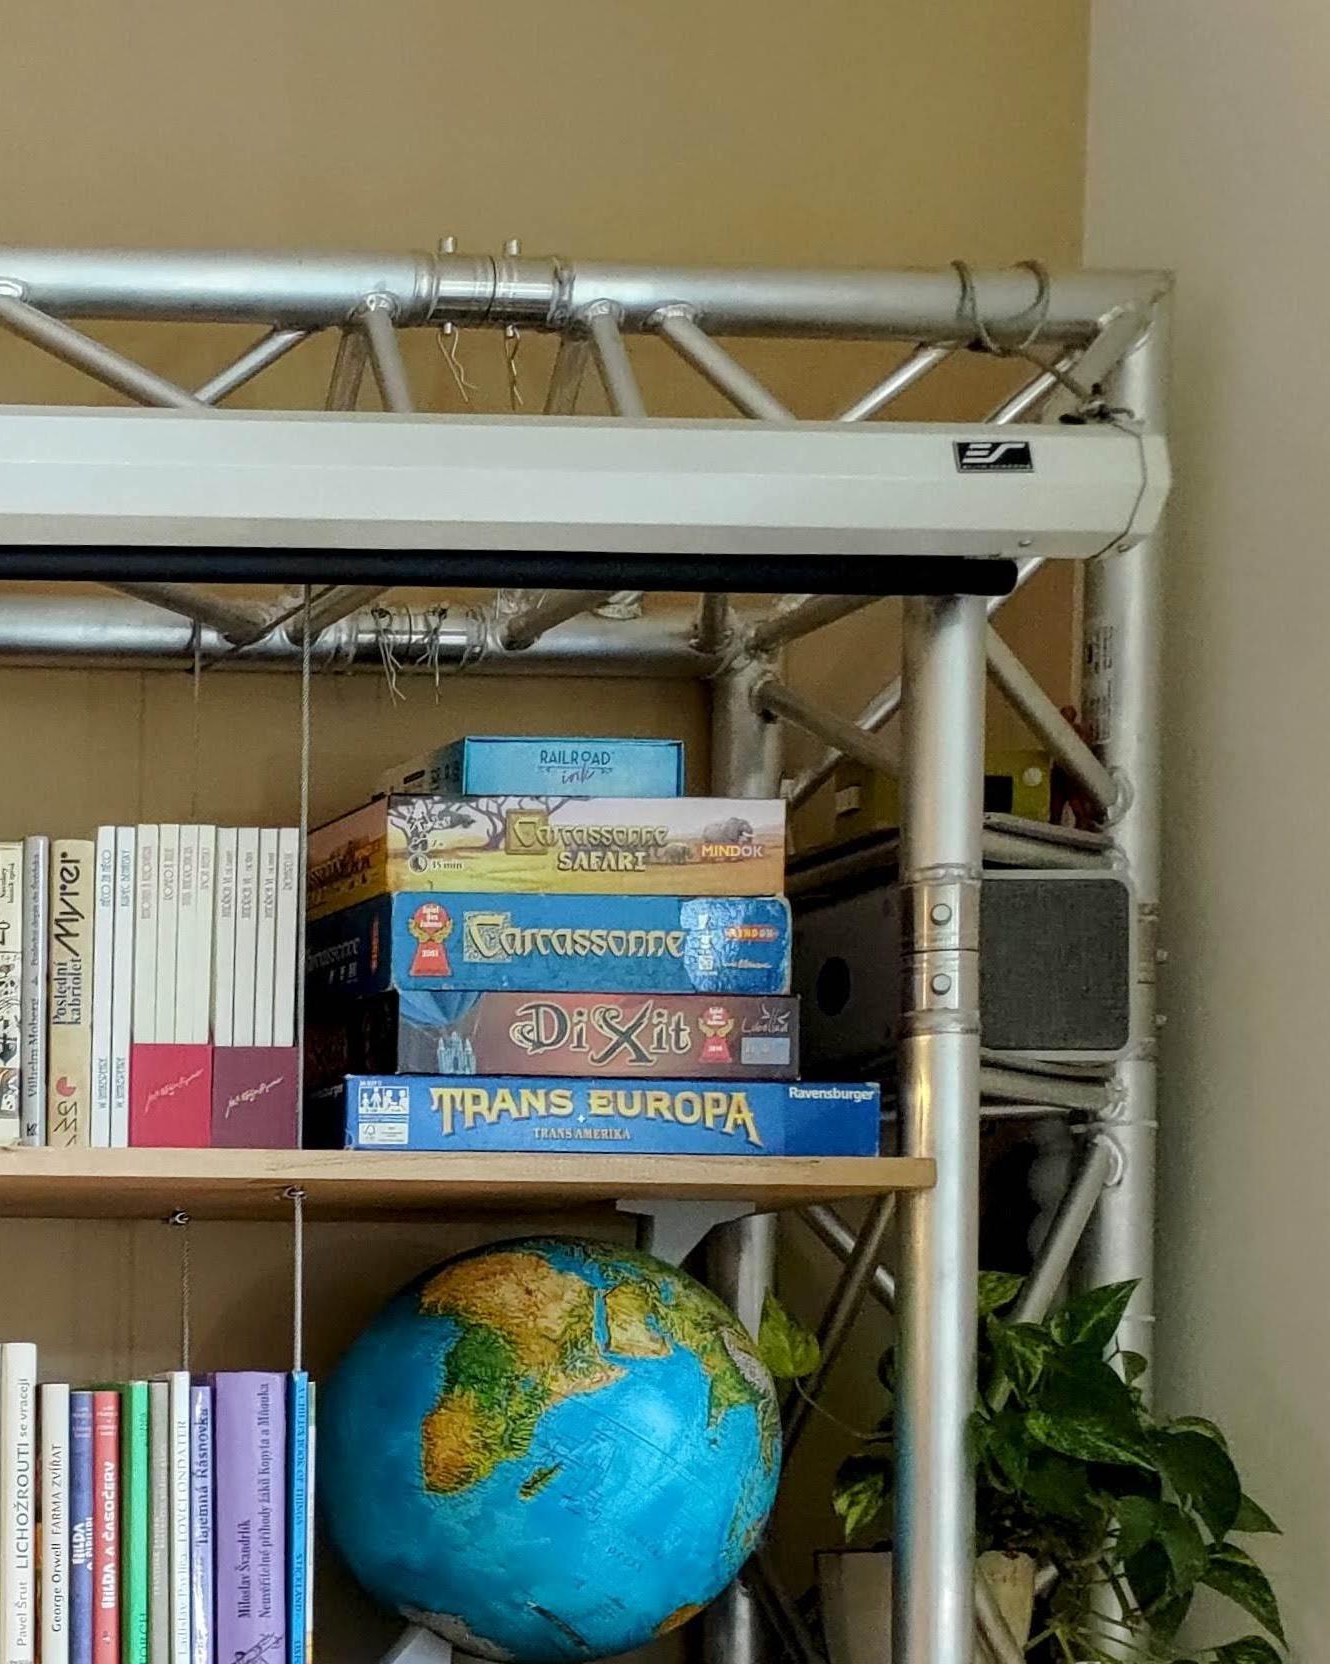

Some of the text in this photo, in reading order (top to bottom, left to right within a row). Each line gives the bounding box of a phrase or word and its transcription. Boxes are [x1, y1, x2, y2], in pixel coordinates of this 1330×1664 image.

[539, 750, 611, 765] RAILROAD
[512, 816, 670, 849] Carcassonne
[701, 843, 764, 858] MINDOK
[557, 850, 648, 873] SAFARI
[52, 851, 85, 1025] Poslední Myrer
[468, 914, 686, 960] Carcassonne
[67, 956, 82, 1025] kabriolet
[788, 1086, 874, 1102] Ravensburger
[429, 1087, 763, 1148] TRANS EUROPA
[532, 1128, 631, 1140] TRANS AMERIKA
[20, 1425, 28, 1438] se
[257, 1438, 272, 1475] Kopyta
[13, 1442, 30, 1569] LICHOŽROUTI
[102, 1461, 116, 1542] ČASOČERV
[194, 1485, 210, 1546] Tajemná
[48, 1443, 64, 1632] George Orwell FARMA ZVÍŘAT
[72, 1522, 85, 1565] HILDA
[100, 1562, 116, 1609] HILDA
[235, 1519, 252, 1619] Miloslav Švandrlík
[15, 1581, 28, 1609] Šrut
[17, 1612, 28, 1647] Pavel
